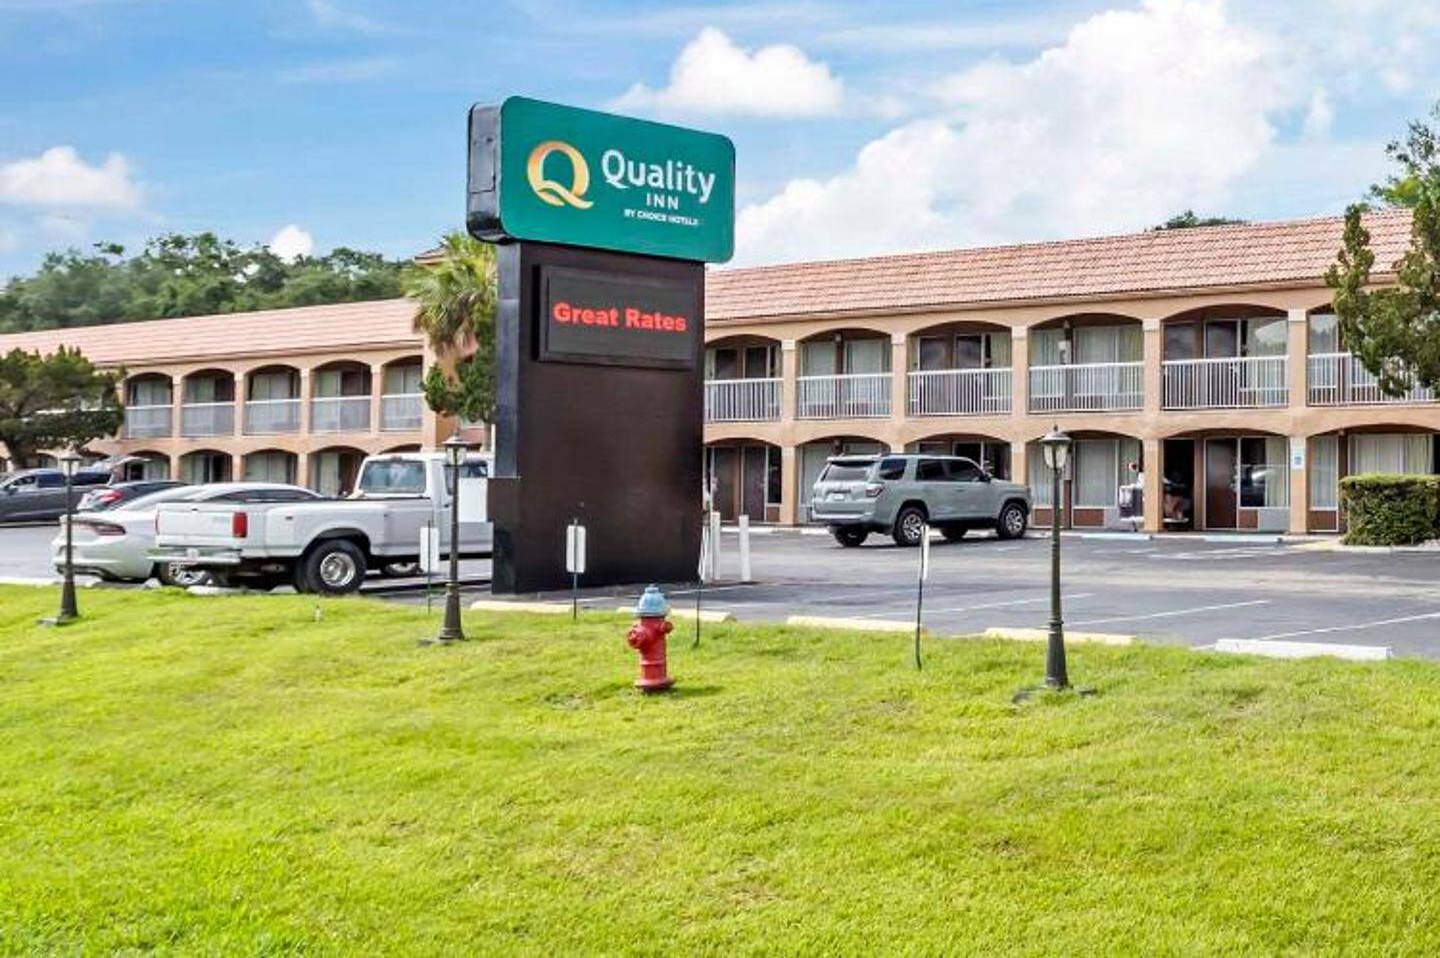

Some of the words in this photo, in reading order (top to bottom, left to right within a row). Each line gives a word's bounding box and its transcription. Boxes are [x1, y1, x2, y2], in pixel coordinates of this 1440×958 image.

[527, 140, 594, 209] Q
[602, 149, 715, 203] Quality
[646, 193, 679, 210] INN
[624, 209, 636, 218] BY
[637, 210, 667, 222] CHOICE
[668, 215, 698, 226] HOTELS
[553, 302, 619, 326] Great
[625, 307, 686, 332] Rates
